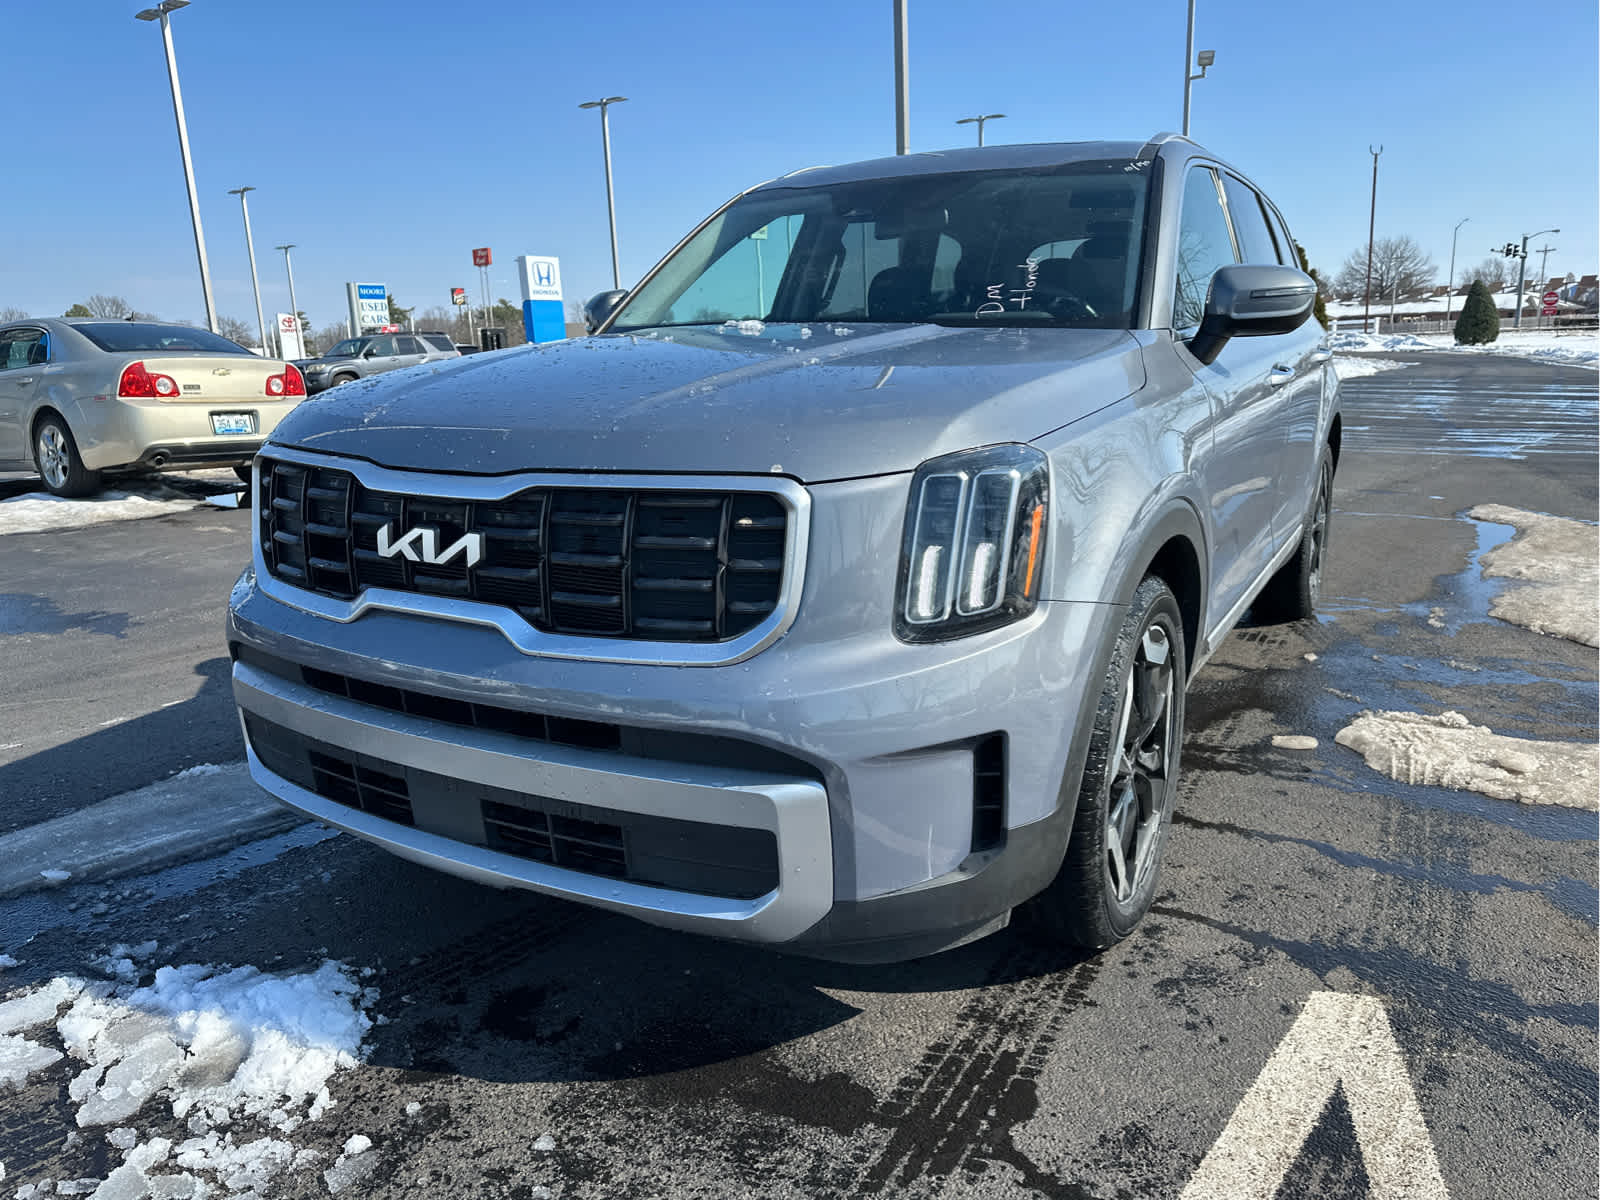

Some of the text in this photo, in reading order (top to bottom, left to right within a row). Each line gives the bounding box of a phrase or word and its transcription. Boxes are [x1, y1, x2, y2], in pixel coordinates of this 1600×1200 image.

[1008, 256, 1041, 309] Honda
[360, 287, 385, 295] MOORE
[361, 301, 388, 312] USED
[361, 314, 389, 324] CARS
[376, 523, 481, 568] KIA
